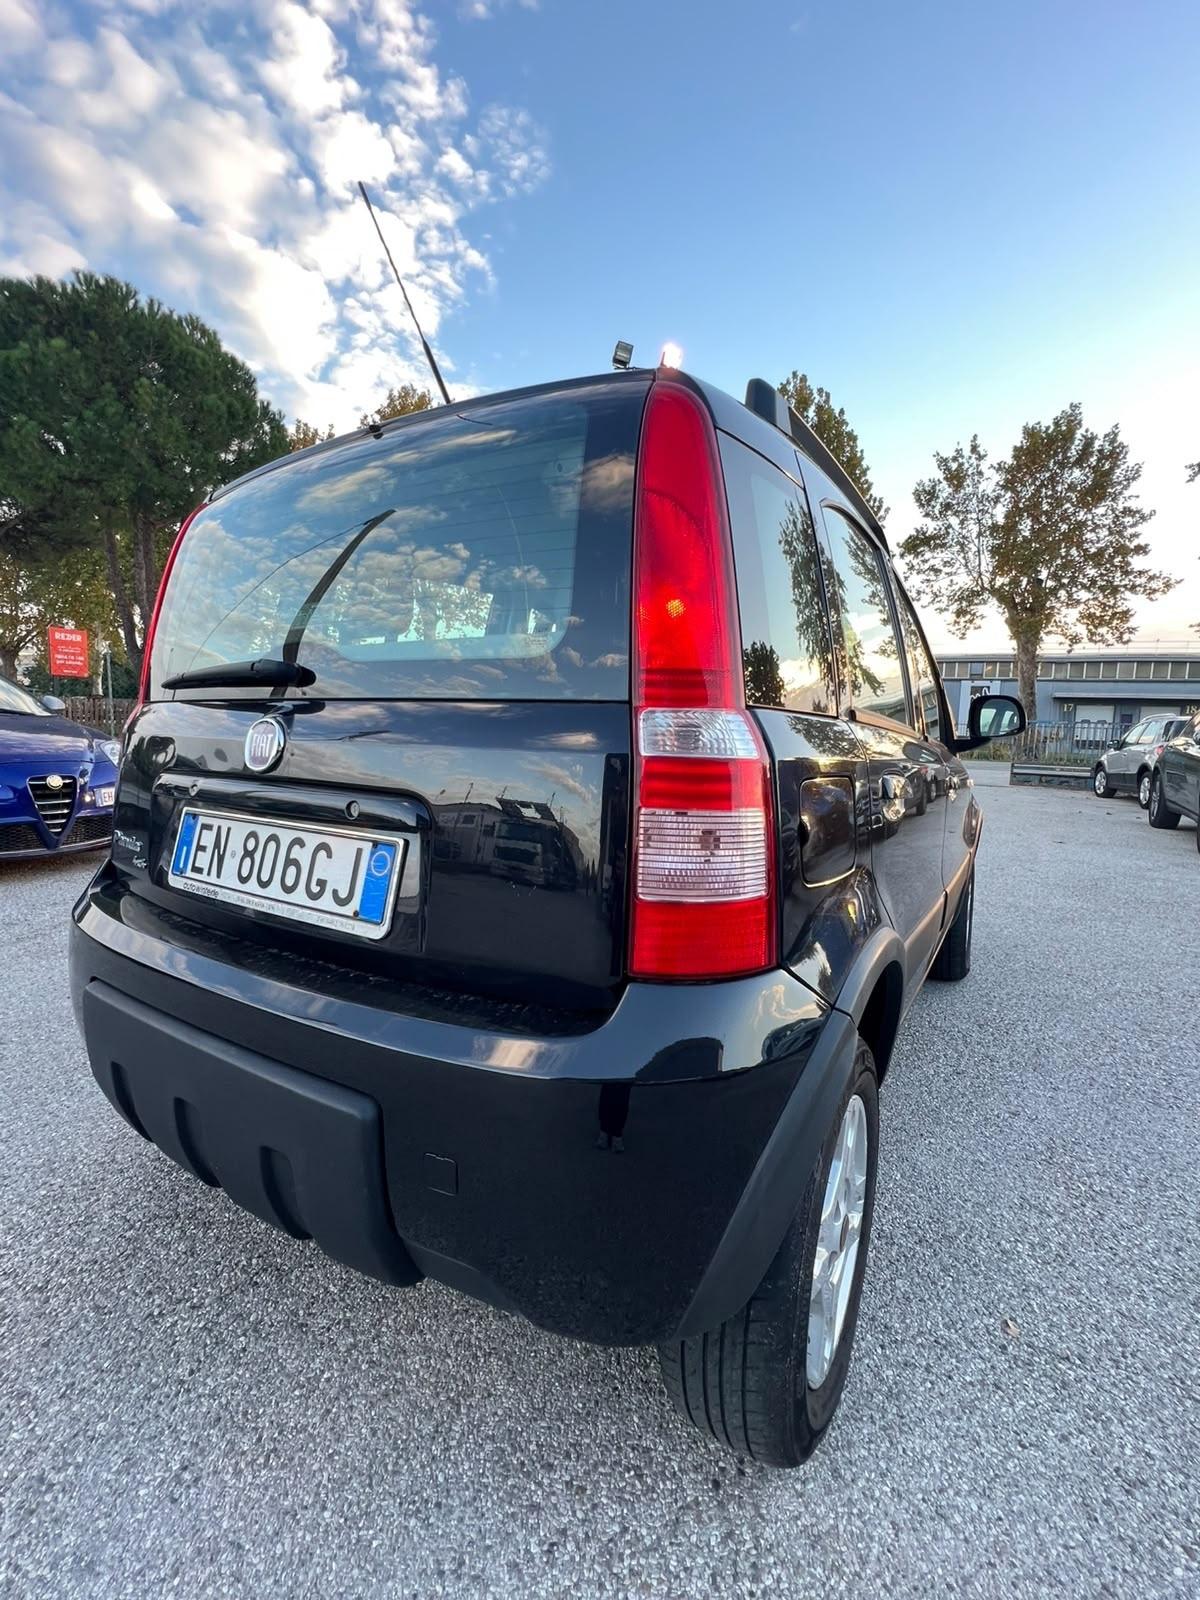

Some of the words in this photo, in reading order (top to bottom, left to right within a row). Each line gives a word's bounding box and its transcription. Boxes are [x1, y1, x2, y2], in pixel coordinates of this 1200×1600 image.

[1063, 703, 1074, 712] 17
[251, 733, 274, 758] FIAT
[191, 822, 232, 879] EN
